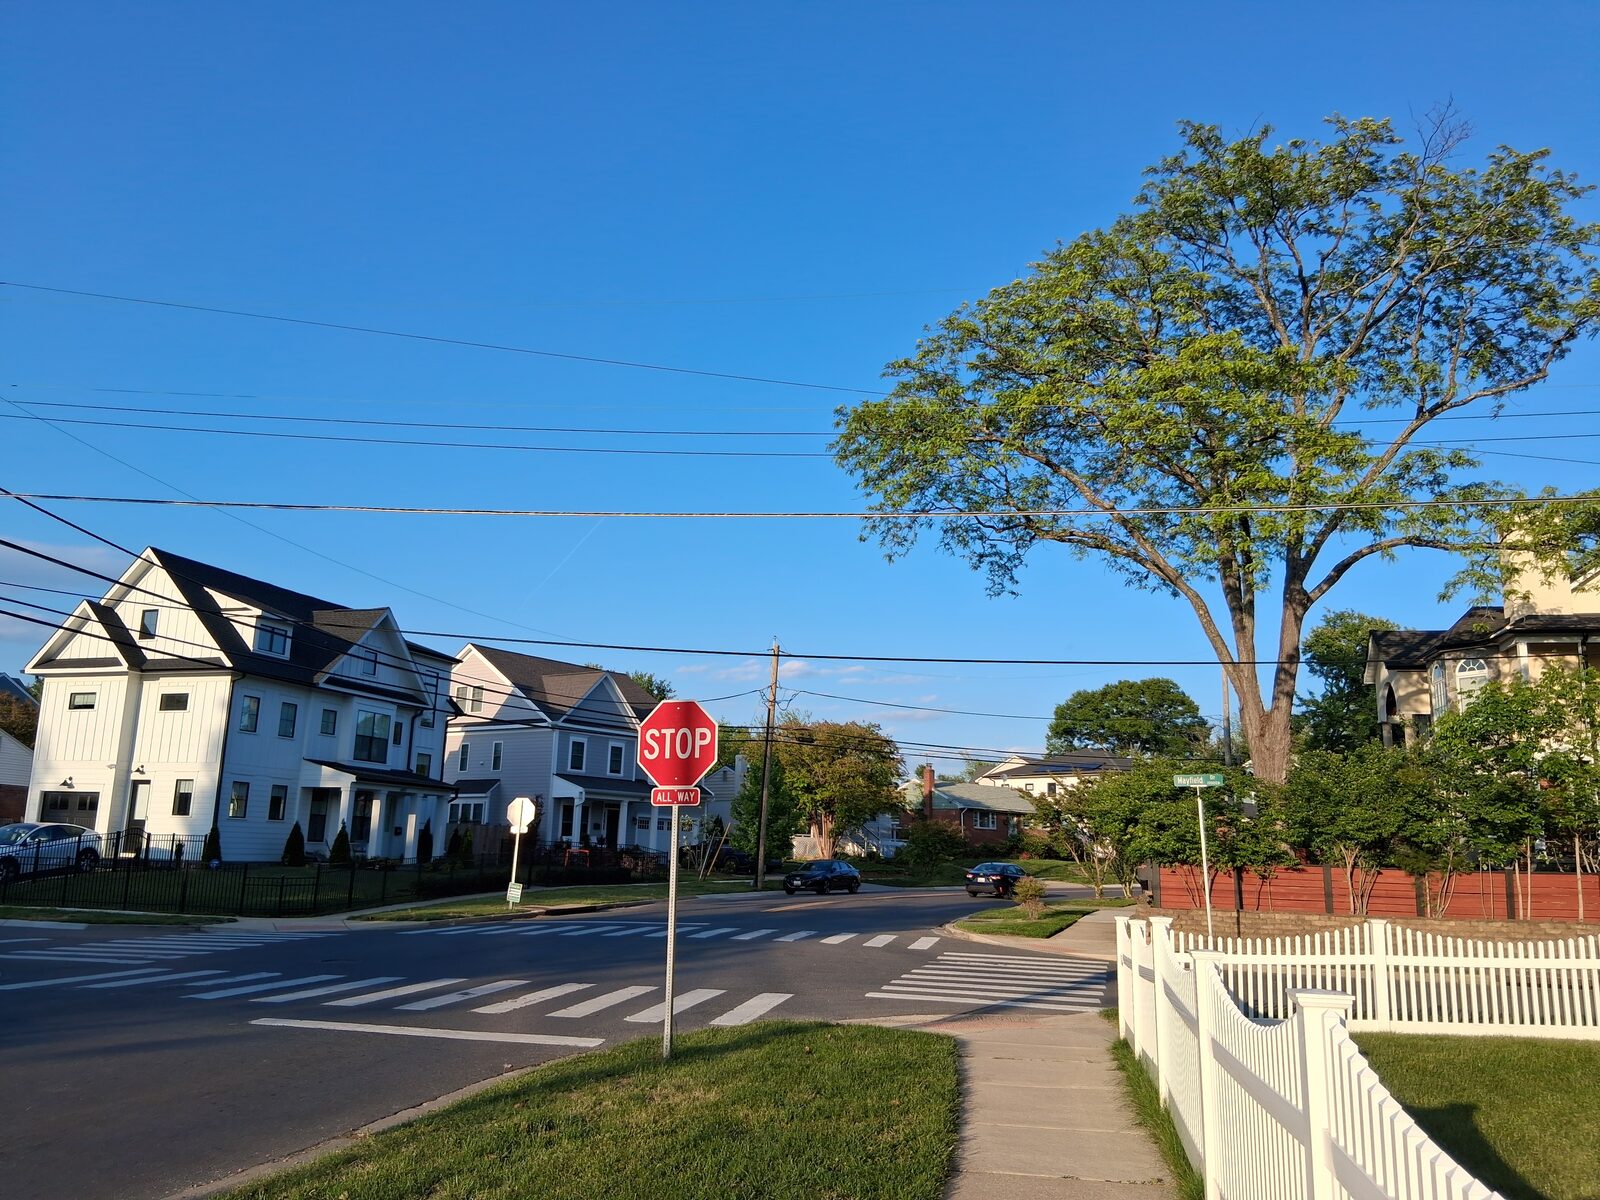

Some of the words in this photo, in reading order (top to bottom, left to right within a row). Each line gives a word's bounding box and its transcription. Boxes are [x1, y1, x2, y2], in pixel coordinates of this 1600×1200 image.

[643, 727, 711, 760] STOP
[1177, 776, 1203, 785] Mayfield
[656, 791, 672, 802] ALL
[677, 791, 695, 802] WAY
